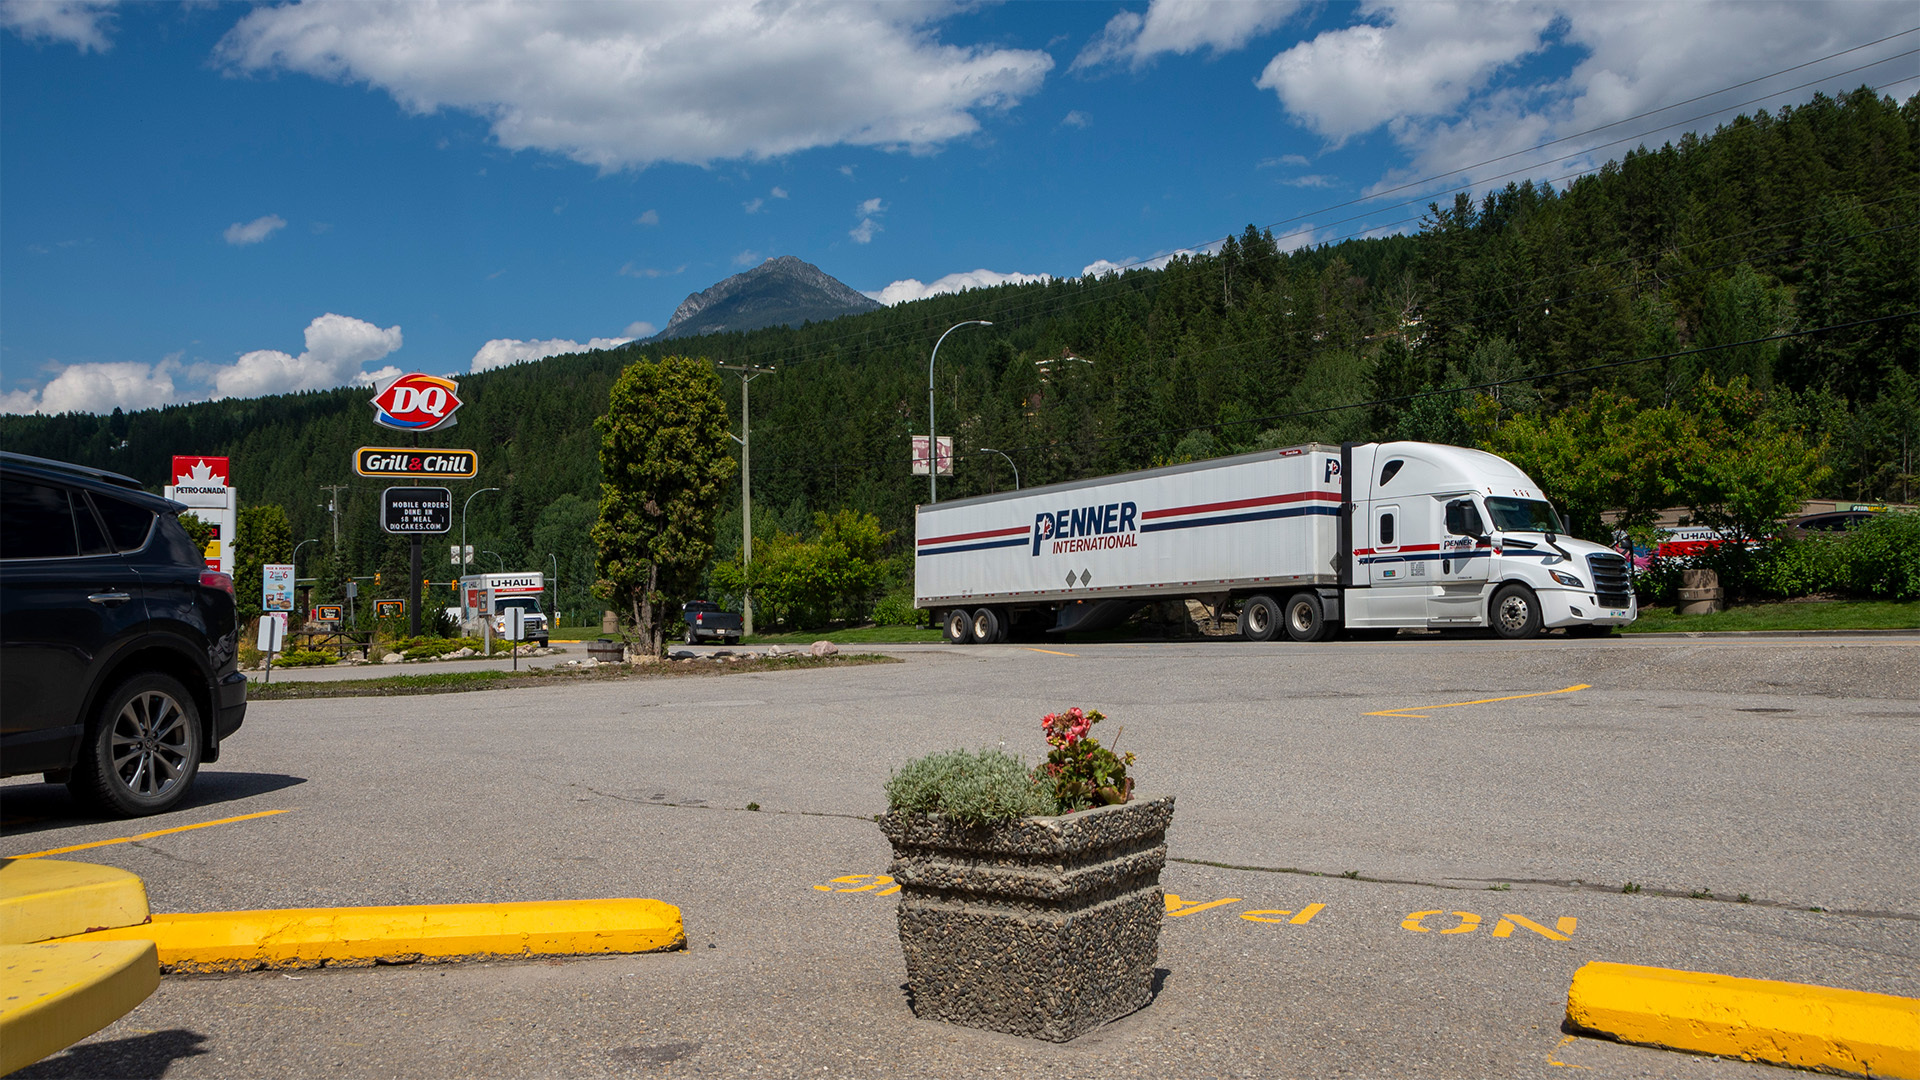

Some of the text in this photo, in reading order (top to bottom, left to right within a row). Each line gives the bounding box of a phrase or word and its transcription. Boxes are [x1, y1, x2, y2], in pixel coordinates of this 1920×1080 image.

[390, 387, 447, 418] DQ
[1032, 501, 1137, 556] PENNER
[1681, 532, 1718, 540] U-HAUL
[1052, 533, 1138, 554] INTERNATIONAL
[1444, 539, 1473, 550] PENNER
[491, 579, 536, 587] U-HAUL
[1401, 910, 1578, 941] NO
